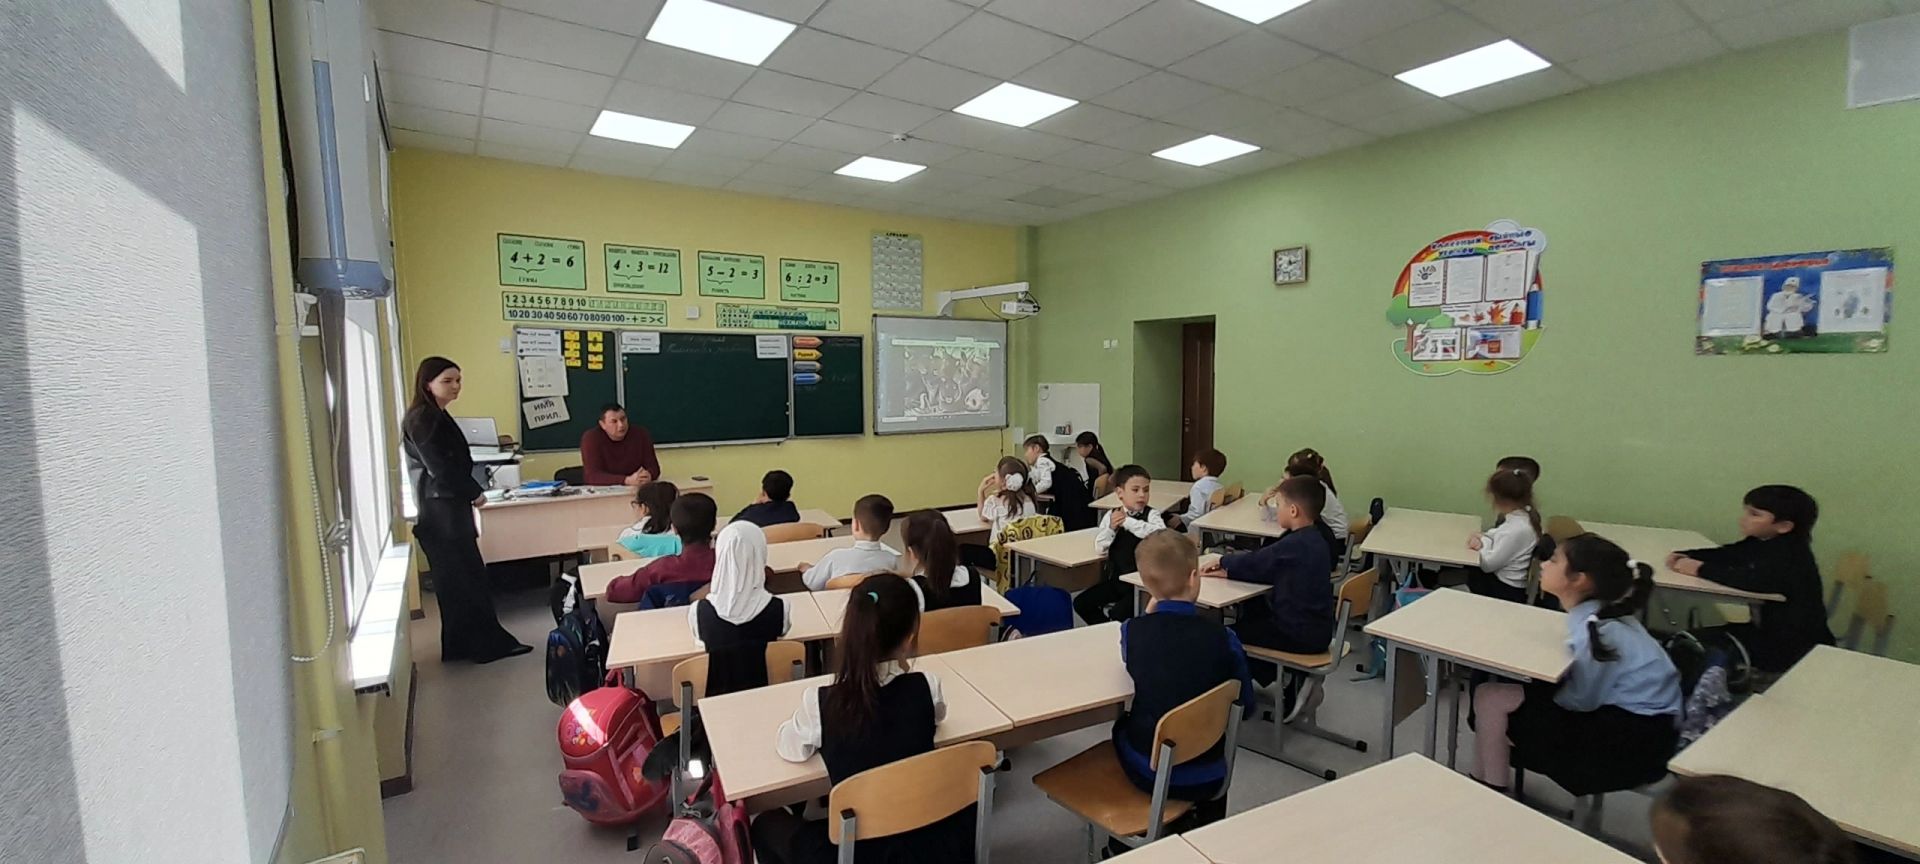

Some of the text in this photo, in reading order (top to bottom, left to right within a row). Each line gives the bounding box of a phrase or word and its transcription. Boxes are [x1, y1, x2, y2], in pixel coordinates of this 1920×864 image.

[510, 251, 519, 264] 4
[536, 253, 546, 266] 2
[566, 255, 575, 268] 6
[613, 259, 621, 271] 4
[636, 260, 644, 272] 3
[657, 262, 670, 274] 12
[706, 265, 714, 276] 5
[728, 267, 736, 278] 2
[752, 269, 758, 280] 3
[786, 272, 792, 282] 6
[806, 273, 812, 284] 2
[822, 274, 828, 285] 3
[505, 295, 510, 303] 1
[512, 295, 518, 303] 2
[520, 295, 526, 304] 3
[528, 296, 534, 304] 4
[537, 296, 543, 304] 5
[545, 296, 551, 304] 6
[561, 297, 566, 305] 8
[568, 298, 574, 306] 9
[576, 298, 586, 306] 10
[508, 310, 518, 318] 10
[519, 310, 530, 318] 20
[532, 310, 542, 318] 30
[544, 311, 554, 320] 40
[556, 312, 566, 320] 50
[567, 312, 578, 320] 60
[579, 313, 589, 321] 70
[600, 314, 610, 322] 90
[612, 314, 625, 322] 100
